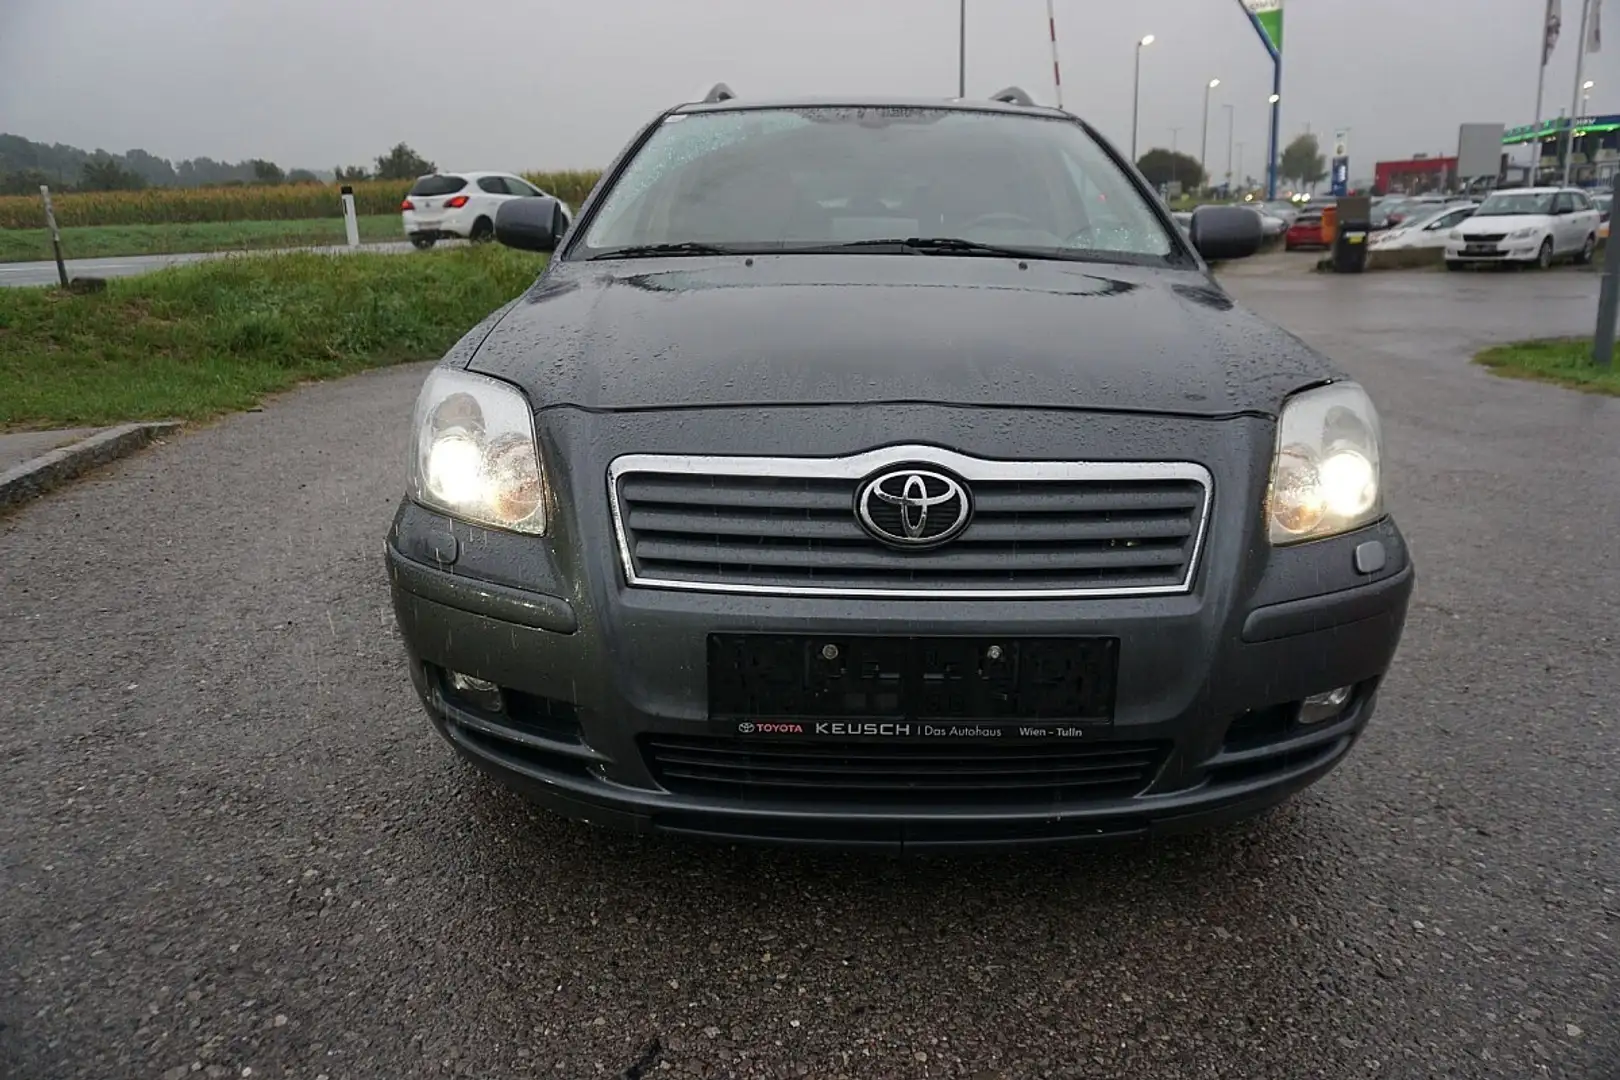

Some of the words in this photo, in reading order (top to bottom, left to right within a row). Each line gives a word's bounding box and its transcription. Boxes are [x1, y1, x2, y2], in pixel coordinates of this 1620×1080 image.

[756, 723, 803, 733] TOYOTA
[815, 723, 910, 735] KEUSCH
[924, 725, 946, 736] Das
[949, 725, 1002, 737] Autohaus
[1019, 726, 1046, 736] Wien
[1056, 727, 1083, 737] Tulln
